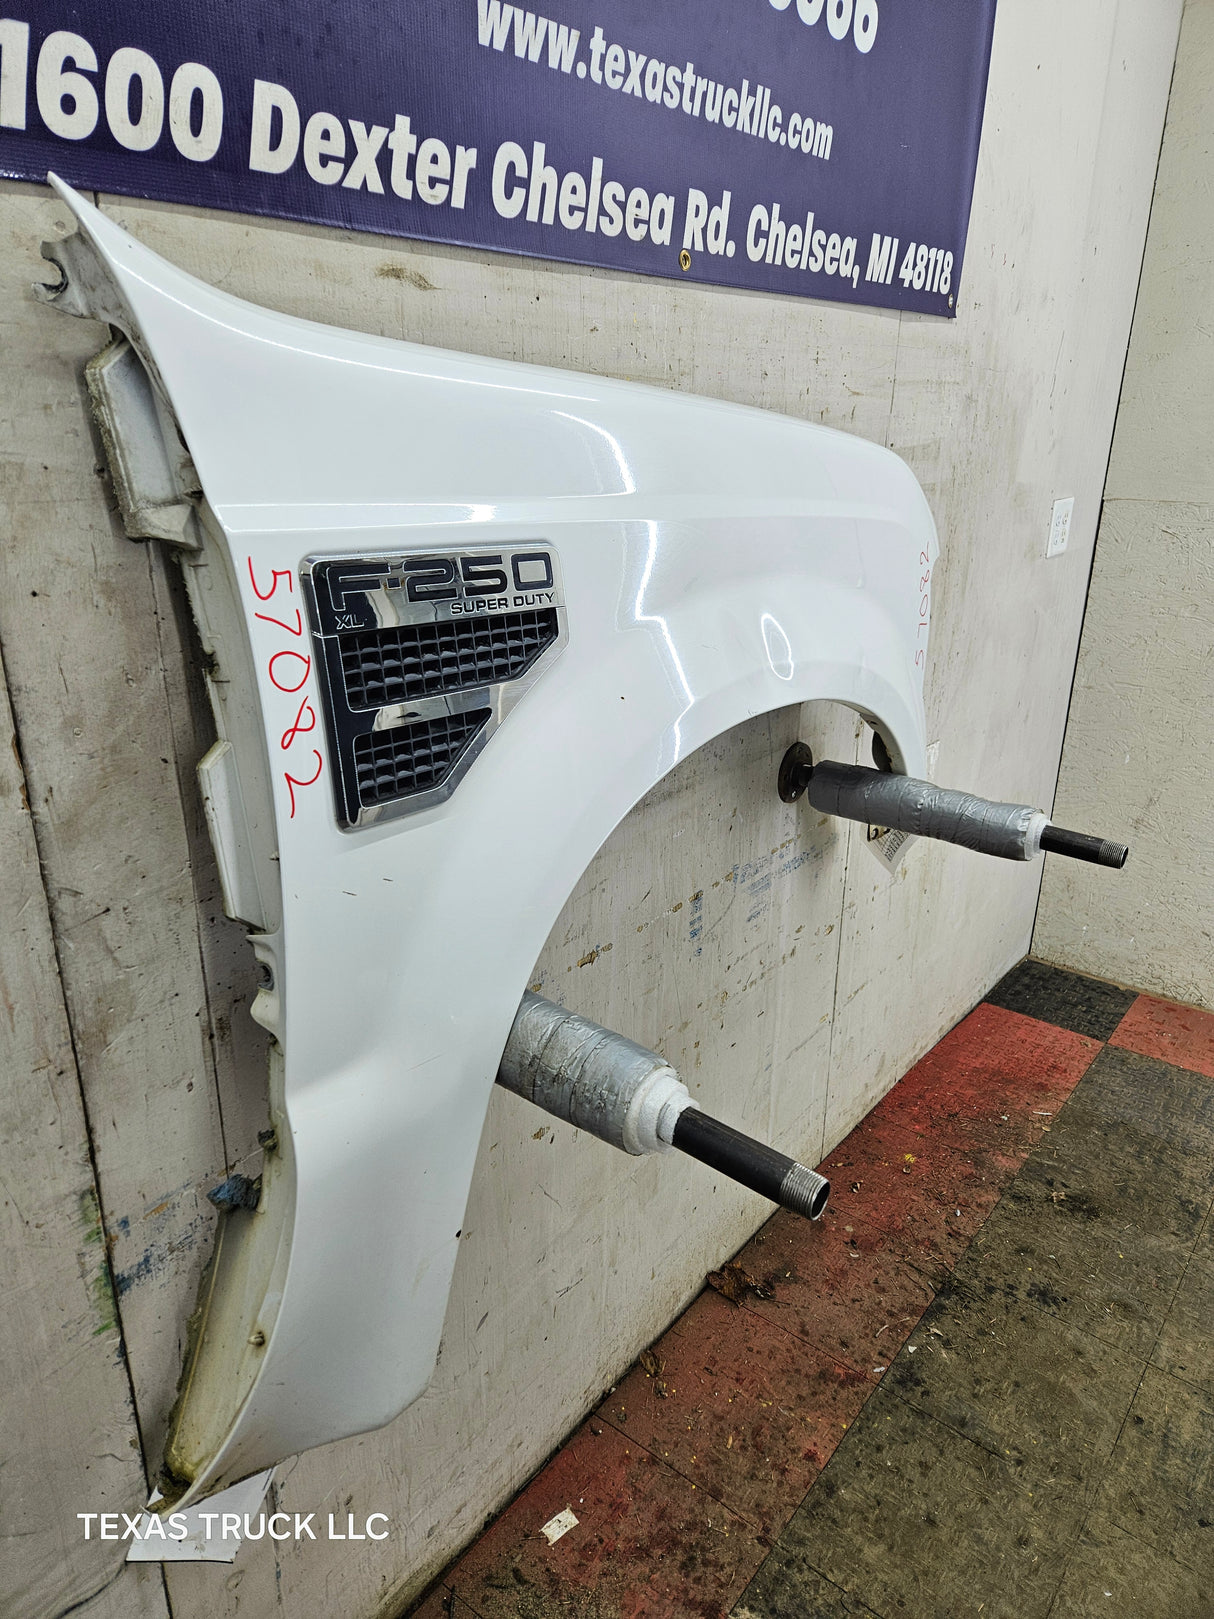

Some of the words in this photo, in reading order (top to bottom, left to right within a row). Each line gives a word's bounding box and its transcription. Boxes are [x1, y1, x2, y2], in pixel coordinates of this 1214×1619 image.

[0, 18, 224, 162] 1600
[248, 79, 478, 210] Dexter
[491, 141, 676, 246] Chelsea
[683, 188, 736, 258] Rd.
[746, 203, 861, 289] Chelsea,
[865, 233, 900, 285] MI
[899, 242, 953, 295] 48118
[476, 0, 834, 160] www.texastruckllc.com
[335, 614, 364, 630] XL
[450, 598, 510, 616] SUPER
[512, 592, 556, 609] DUTY
[248, 556, 322, 818] 57082
